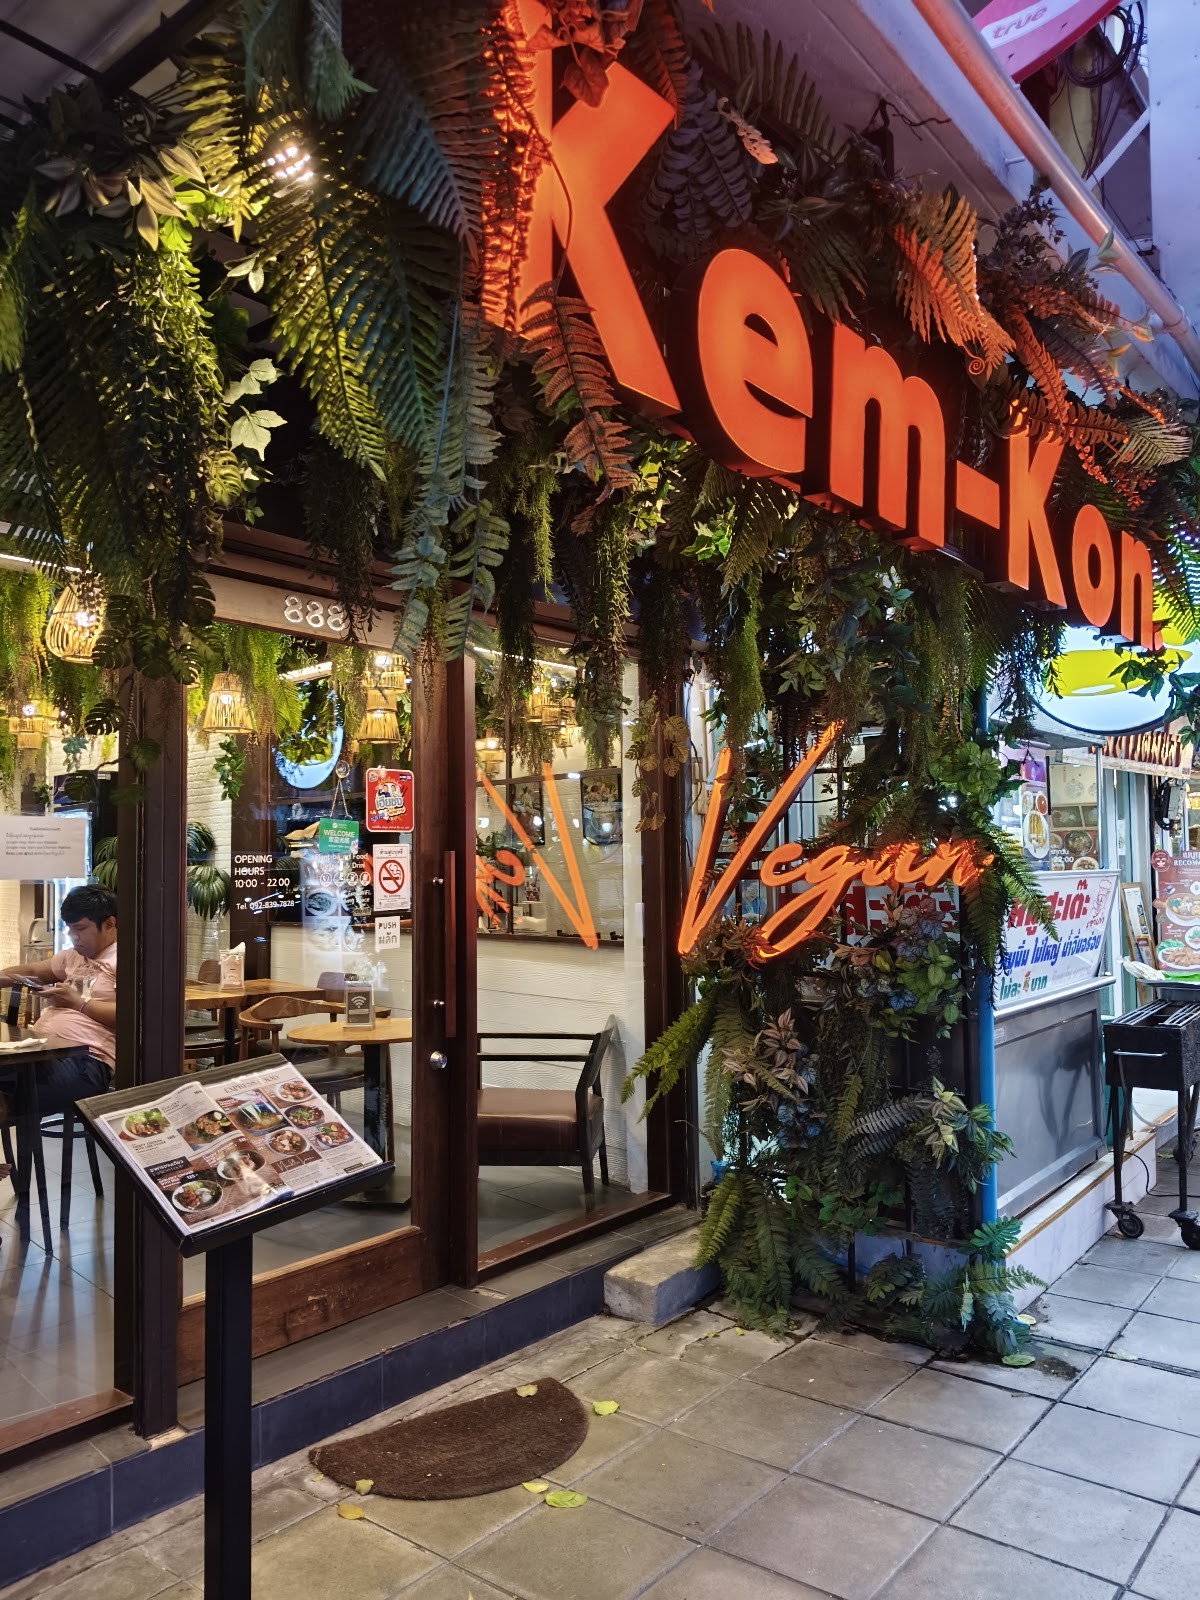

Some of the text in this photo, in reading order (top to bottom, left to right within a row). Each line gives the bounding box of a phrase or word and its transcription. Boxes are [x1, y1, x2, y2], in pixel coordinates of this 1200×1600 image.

[993, 7, 1047, 39] true
[484, 0, 1163, 652] Kem-Kon
[284, 595, 346, 631] 888
[323, 829, 355, 838] WELCOME
[678, 720, 994, 958] Vegan
[234, 854, 273, 864] OPENING
[234, 866, 265, 876] HOURS
[378, 921, 397, 930] PUSH
[378, 931, 398, 945] ผลัก
[1030, 975, 1048, 992] บาท
